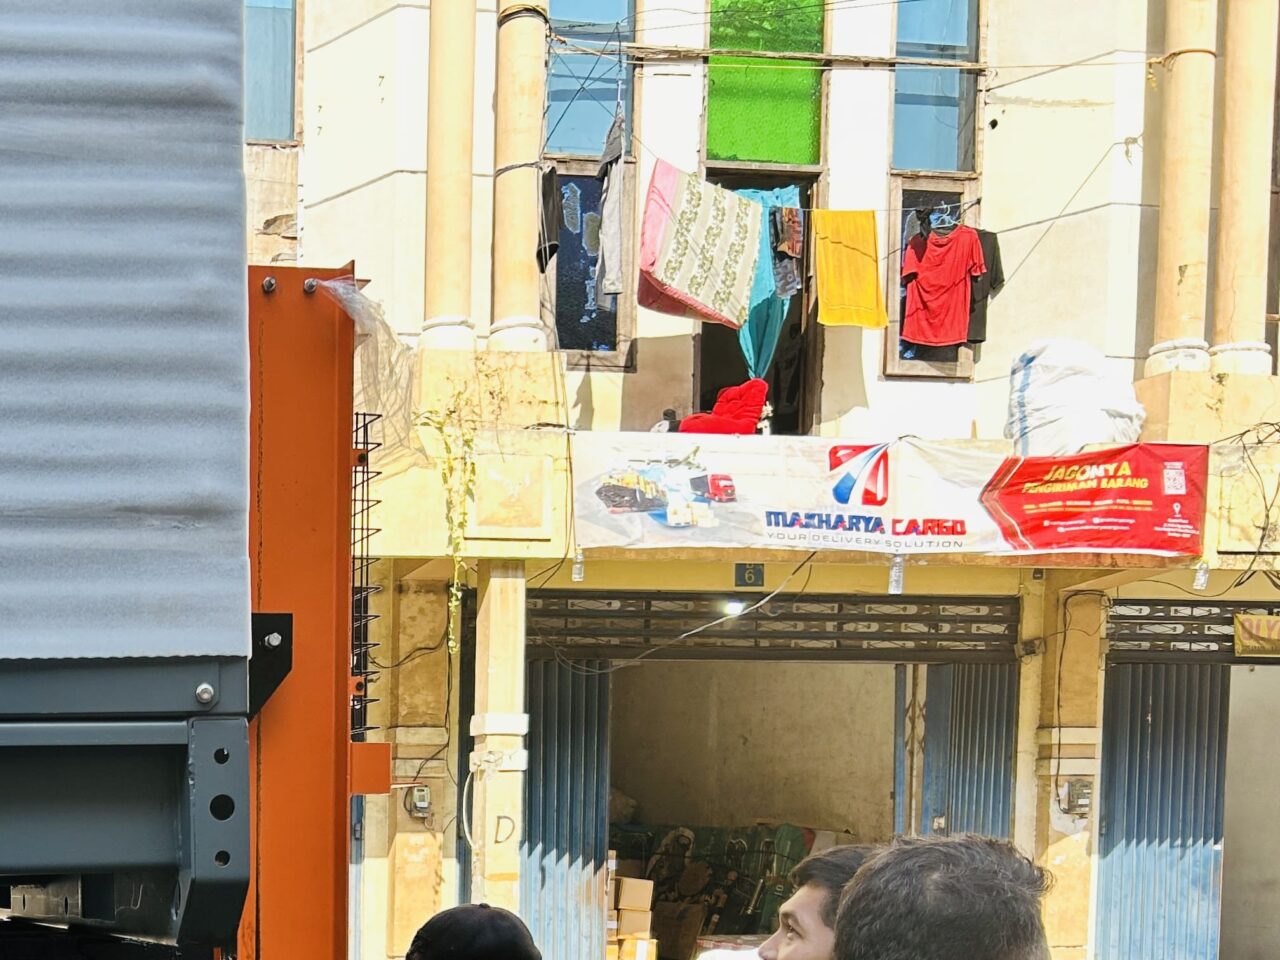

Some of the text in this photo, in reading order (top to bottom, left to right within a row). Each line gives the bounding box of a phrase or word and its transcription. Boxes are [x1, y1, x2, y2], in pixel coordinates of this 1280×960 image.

[1043, 461, 1132, 481] JAGONYA
[1100, 478, 1149, 489] BARANG
[765, 511, 968, 536] MAKHARYA CARGO
[767, 532, 964, 548] YOUR DELIVERY SOLUTION
[745, 569, 755, 584] 6
[494, 815, 516, 844] D
